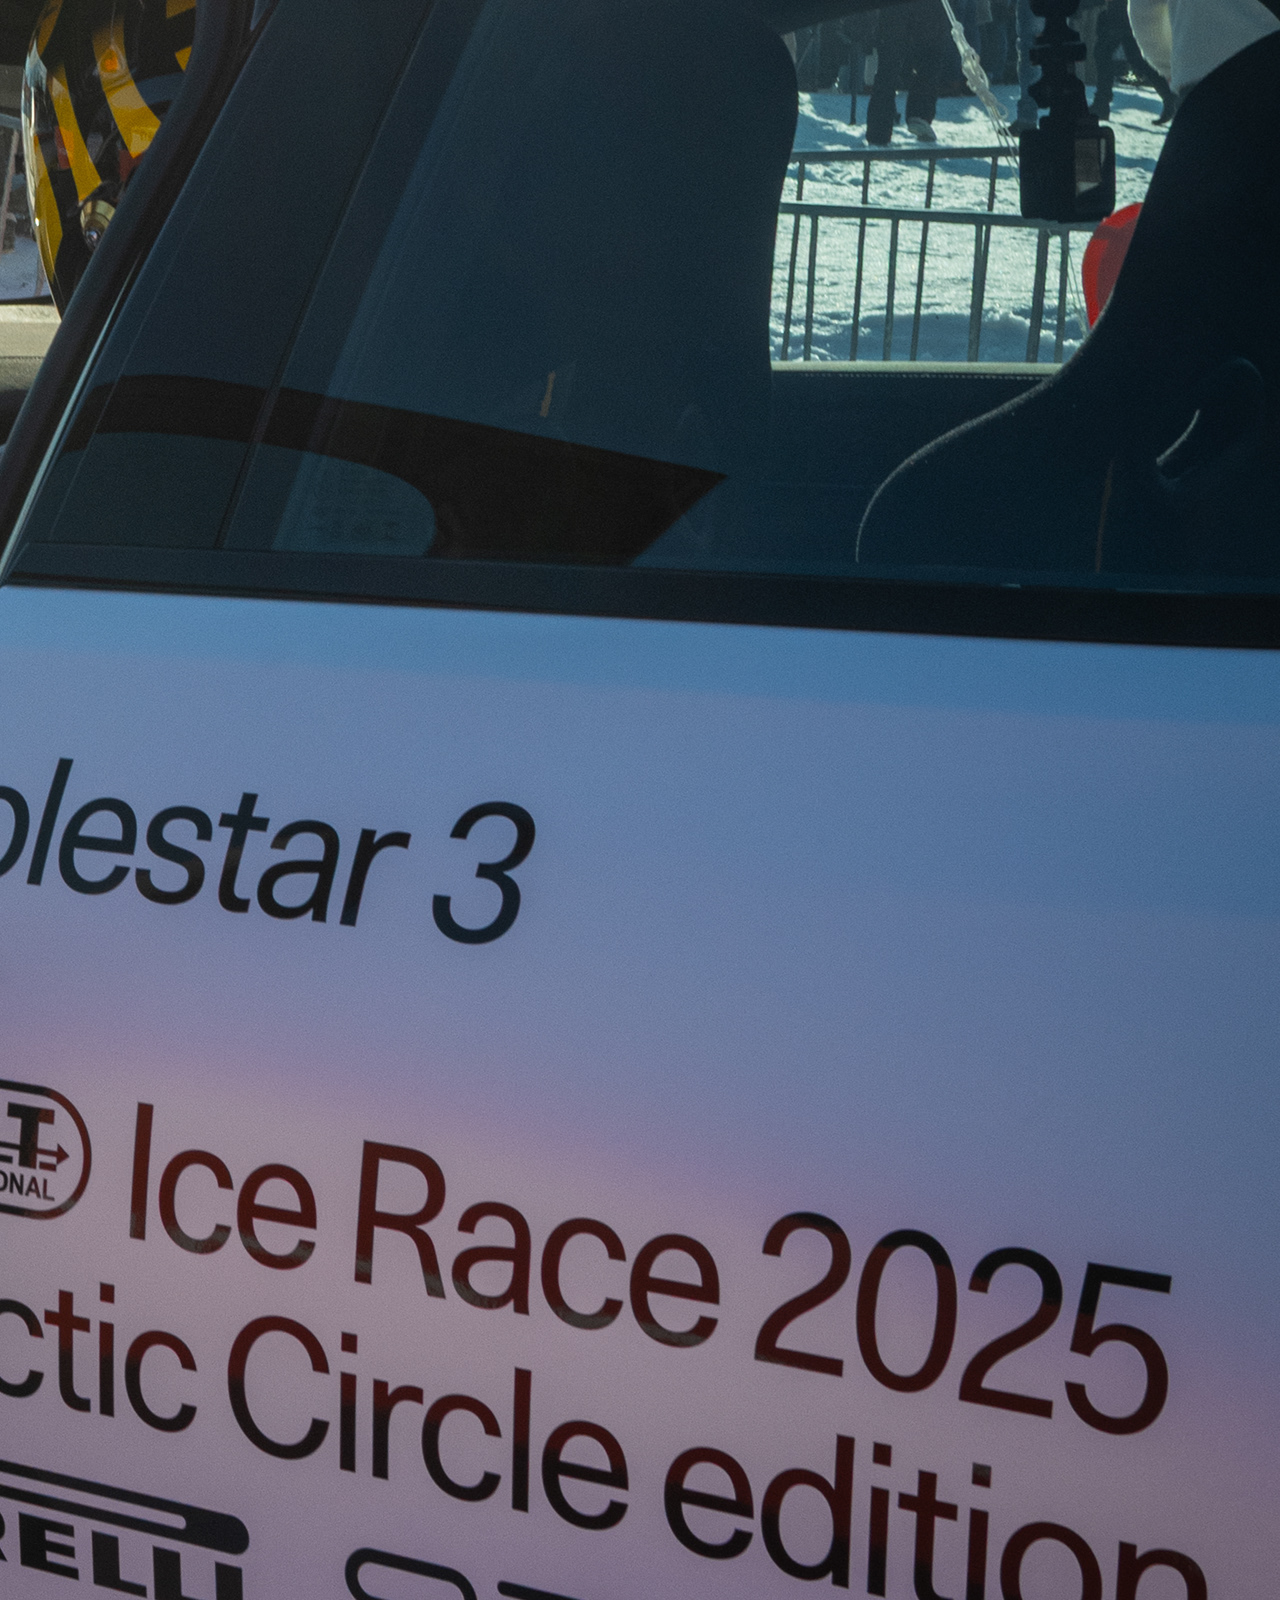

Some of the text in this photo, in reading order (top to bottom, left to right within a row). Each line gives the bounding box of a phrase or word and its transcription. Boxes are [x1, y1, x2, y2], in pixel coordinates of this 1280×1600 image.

[432, 800, 537, 945] 3
[129, 1101, 1173, 1437] Ice Race 2025
[227, 1315, 630, 1531] Circle
